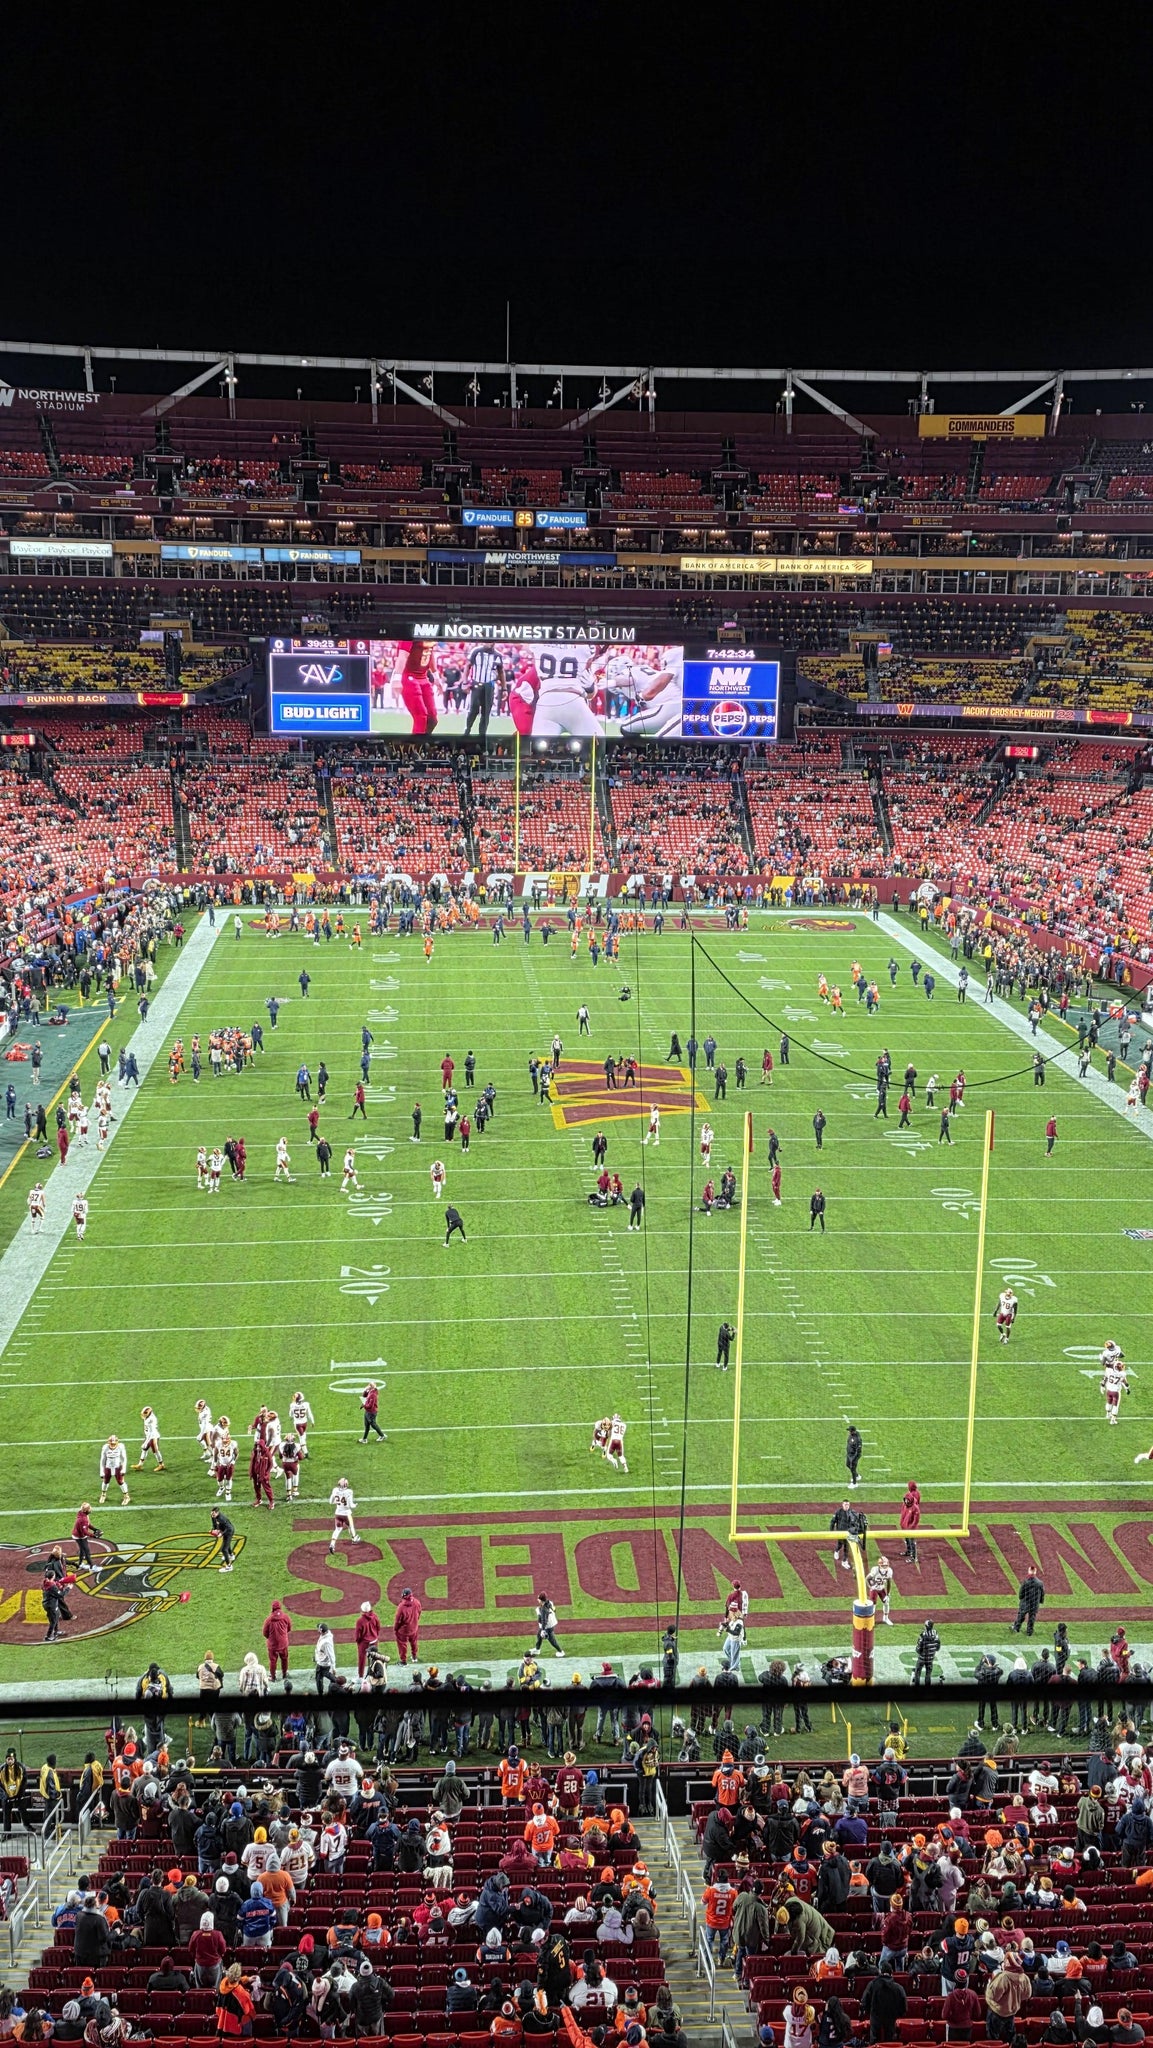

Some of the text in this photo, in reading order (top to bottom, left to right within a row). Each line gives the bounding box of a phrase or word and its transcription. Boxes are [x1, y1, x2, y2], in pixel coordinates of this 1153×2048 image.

[18, 389, 100, 403] NORTHWEST
[36, 401, 85, 411] STADIUM
[949, 420, 1015, 432] COMMANDERS
[476, 514, 512, 522] FANDUEL
[517, 513, 532, 524] 25
[549, 516, 585, 524] FANDUEL
[13, 545, 43, 553] Paycor
[48, 546, 77, 554] Paycor
[82, 547, 111, 555] Paycor
[300, 552, 333, 560] FANDUEL
[444, 624, 552, 638] NORTHWEST
[556, 626, 636, 640] STADIUM
[274, 640, 284, 649] 0
[357, 641, 366, 650] 0
[707, 649, 755, 658] 7:42:34
[709, 667, 751, 686] NW
[27, 695, 74, 703] RUNNING
[283, 706, 359, 719] BUD LIGHT
[714, 714, 744, 722] PEPSI
[962, 706, 1075, 720] JACORY CROSKEY-MERRITT 22
[749, 715, 776, 723] PEPSI
[883, 1130, 933, 1150] 40
[346, 1191, 393, 1217] 30
[930, 1187, 983, 1211] 30
[989, 1257, 1057, 1287] 20
[338, 1264, 391, 1295] 20
[328, 1357, 387, 1394] 10
[293, 1408, 306, 1419] 55
[220, 1448, 231, 1458] 94
[508, 1773, 519, 1787] 15
[721, 1778, 736, 1790] 58
[563, 1780, 578, 1794] 28
[1107, 1812, 1121, 1823] 21
[536, 1829, 551, 1844] 87
[256, 1857, 264, 1869] 5
[289, 1856, 306, 1871] 21
[715, 1899, 727, 1915] 2
[957, 1950, 970, 1965] 10
[586, 1991, 605, 2007] 21
